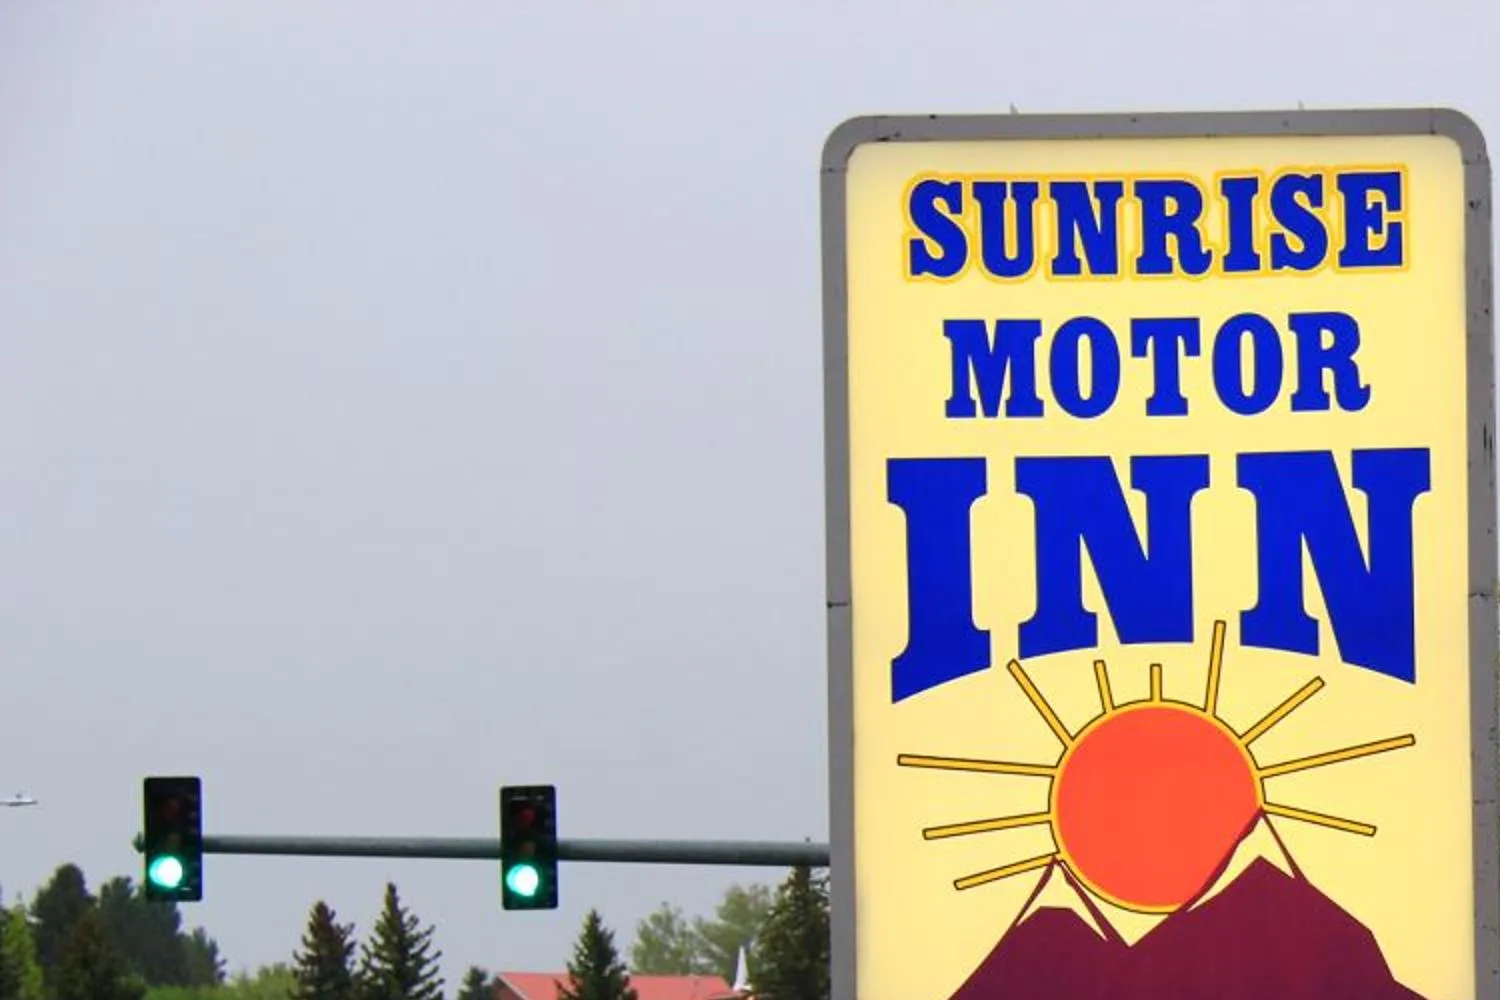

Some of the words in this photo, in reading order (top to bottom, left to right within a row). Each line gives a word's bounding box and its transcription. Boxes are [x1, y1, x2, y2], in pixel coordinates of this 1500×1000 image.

[909, 171, 1403, 278] SUNRISE
[943, 312, 1371, 419] MOTOR
[886, 448, 1431, 704] INN
